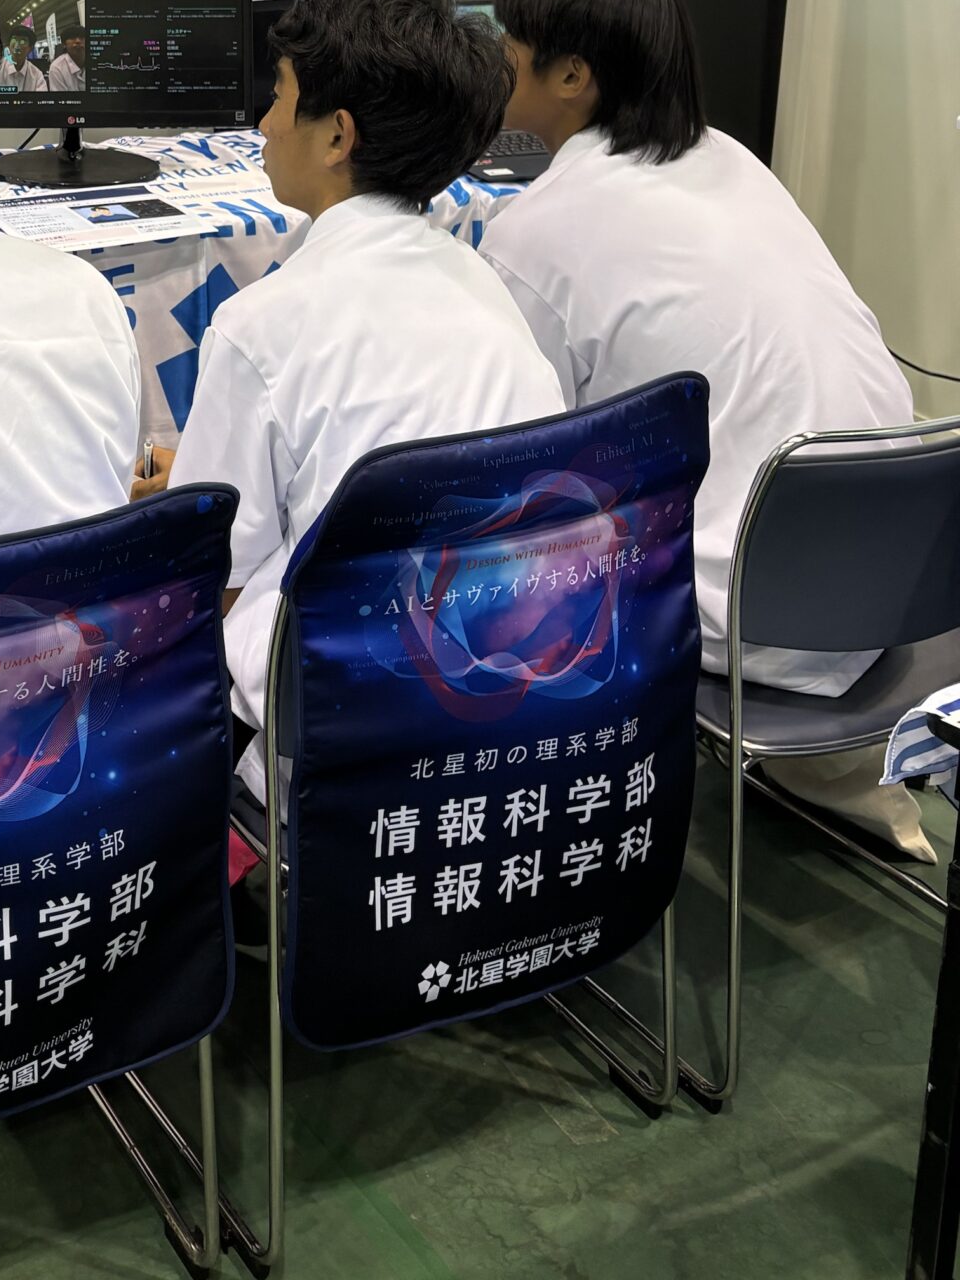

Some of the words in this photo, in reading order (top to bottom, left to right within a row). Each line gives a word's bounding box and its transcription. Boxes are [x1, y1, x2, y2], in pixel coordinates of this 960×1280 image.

[383, 544, 646, 616] AIとサヴァイヴする人間性を。
[410, 717, 640, 781] 北星初の理系学部
[368, 752, 656, 858] 情報科学部
[367, 818, 653, 932] 情報科学科
[453, 927, 601, 994] 北星学園大学
[457, 942, 505, 968] Hokusei
[505, 932, 548, 953] Gakuen
[550, 915, 604, 939] University
[32, 1017, 94, 1057] University
